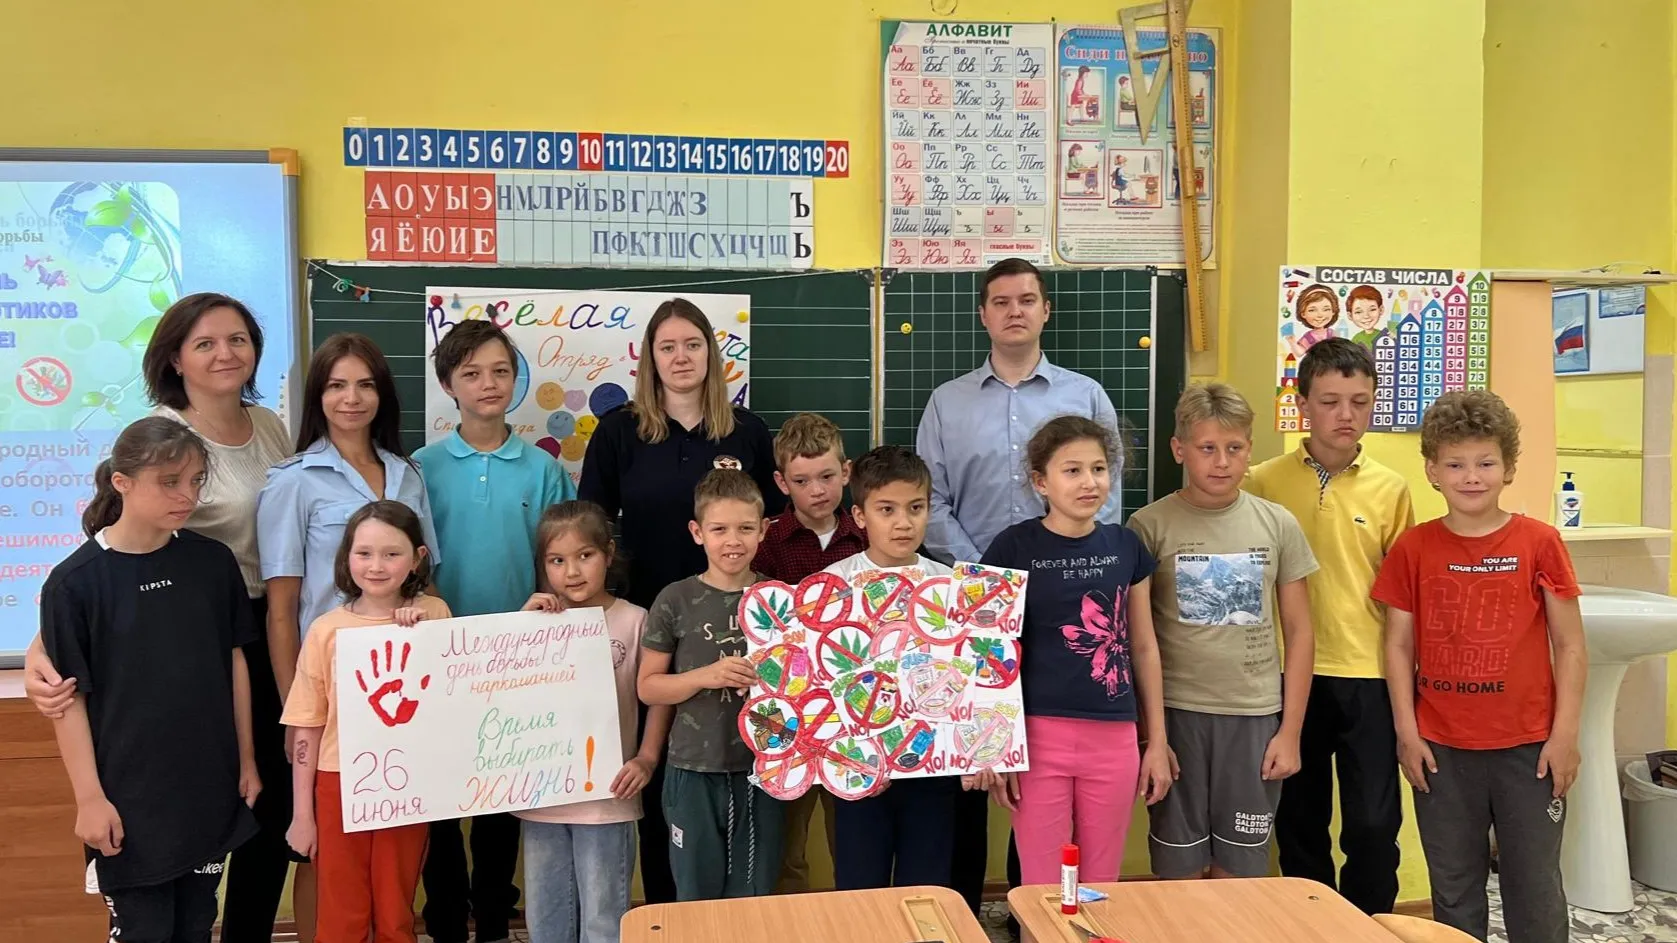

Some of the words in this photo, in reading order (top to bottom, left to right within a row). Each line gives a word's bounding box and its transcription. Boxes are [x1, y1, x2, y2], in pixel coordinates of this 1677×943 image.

[926, 24, 1013, 37] АЛФАВИТ
[1064, 45, 1110, 62] Сиди
[349, 134, 362, 160] 0
[373, 134, 384, 161] 1
[396, 135, 409, 161] 2
[420, 135, 432, 161] 3
[443, 136, 458, 162] 4
[467, 136, 480, 162] 5
[490, 137, 504, 163] 6
[514, 137, 527, 163] 7
[537, 138, 551, 164] 8
[560, 138, 573, 164] 9
[580, 139, 601, 164] 10
[605, 140, 625, 166] 11
[630, 141, 652, 167] 12
[655, 142, 676, 168] 13
[681, 143, 703, 169] 14
[706, 144, 727, 170] 15
[731, 144, 752, 171] 16
[755, 145, 776, 171] 17
[779, 146, 800, 172] 18
[803, 146, 824, 172] 19
[826, 146, 848, 172] 20
[1320, 269, 1386, 283] СОСТАВ
[1392, 271, 1449, 285] ЧИСЛА
[0, 301, 78, 319] ТИКОВ
[537, 335, 613, 382] Отряд
[31, 500, 63, 517] Он
[1031, 559, 1068, 570] FOREVER
[1070, 558, 1087, 568] AND
[1090, 556, 1119, 567] ALWAYS
[1449, 564, 1471, 572] YOUR
[1063, 569, 1075, 579] BE
[1078, 568, 1104, 579] HAPPY
[140, 579, 172, 591] KIPSTA
[999, 613, 1022, 634] NO!
[441, 620, 606, 662] Международный
[446, 660, 484, 695] день
[470, 664, 577, 701] наркоманией
[1433, 680, 1452, 691] GO
[1456, 681, 1505, 694] HOME
[477, 707, 557, 743] Время
[353, 748, 409, 796] 26
[351, 797, 427, 824] июня
